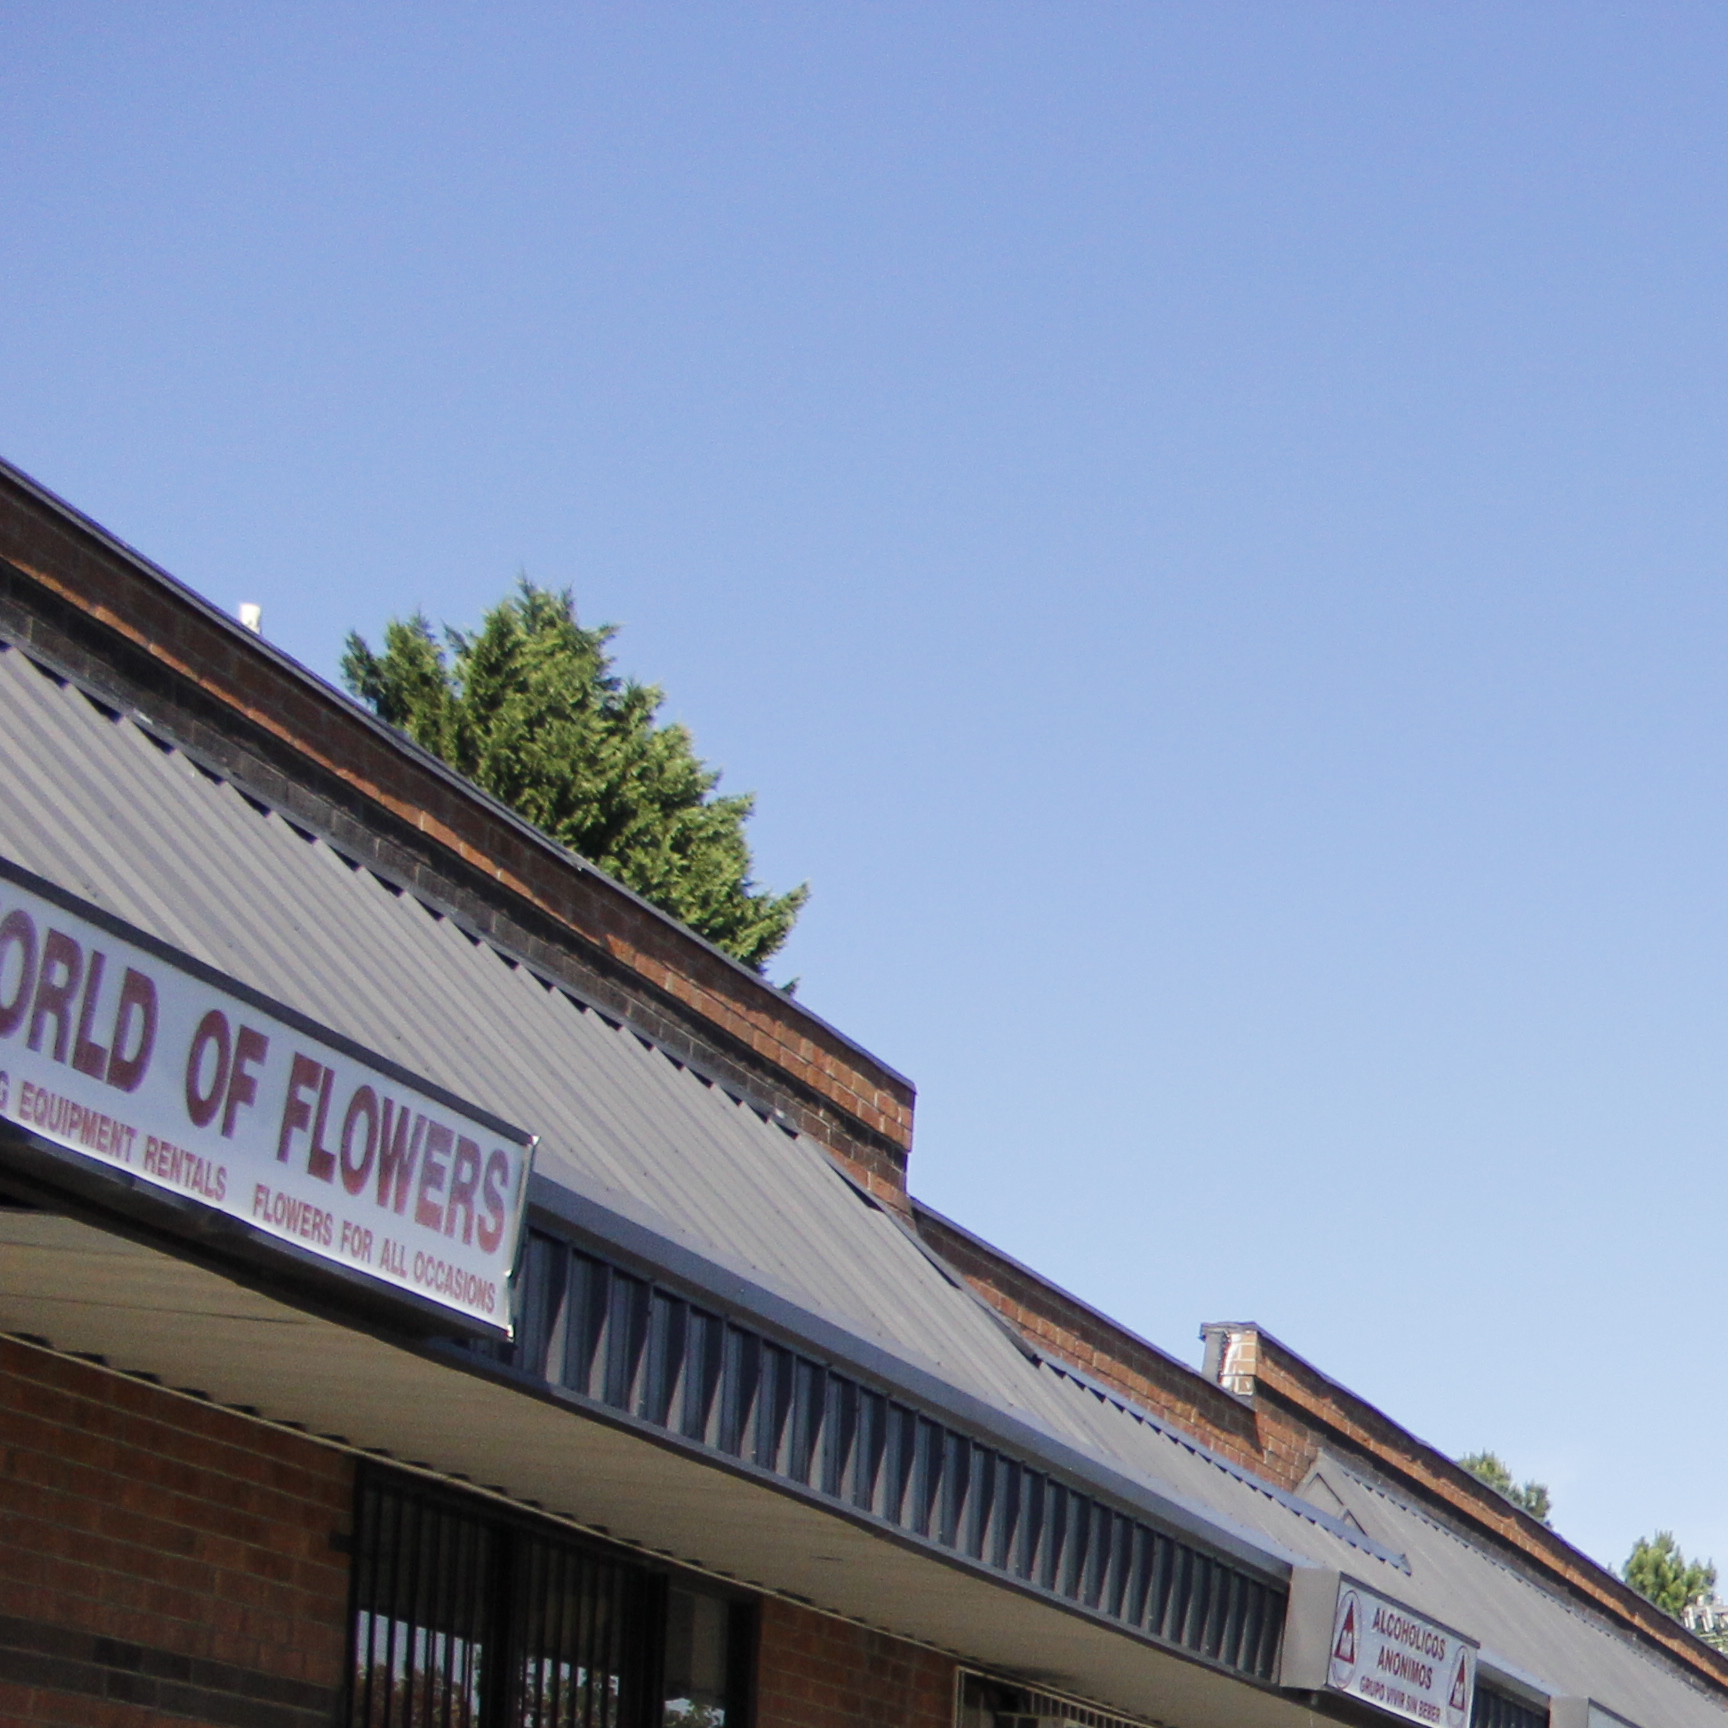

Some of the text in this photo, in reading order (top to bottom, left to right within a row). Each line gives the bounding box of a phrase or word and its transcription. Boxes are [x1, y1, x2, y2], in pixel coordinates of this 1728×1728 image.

[19, 1080, 138, 1163] EQUIPMENT
[144, 1135, 228, 1202] RENTALS
[253, 1183, 334, 1246] FLOWERS
[341, 1220, 373, 1263] FOR
[380, 1238, 408, 1279] ALL
[414, 1251, 495, 1314] OCCASIONS
[186, 1009, 270, 1139] OF
[276, 1051, 509, 1255] FLOWERS
[1372, 1607, 1446, 1661] ALCOHOLICOS
[1377, 1645, 1433, 1690] ANONIMOS
